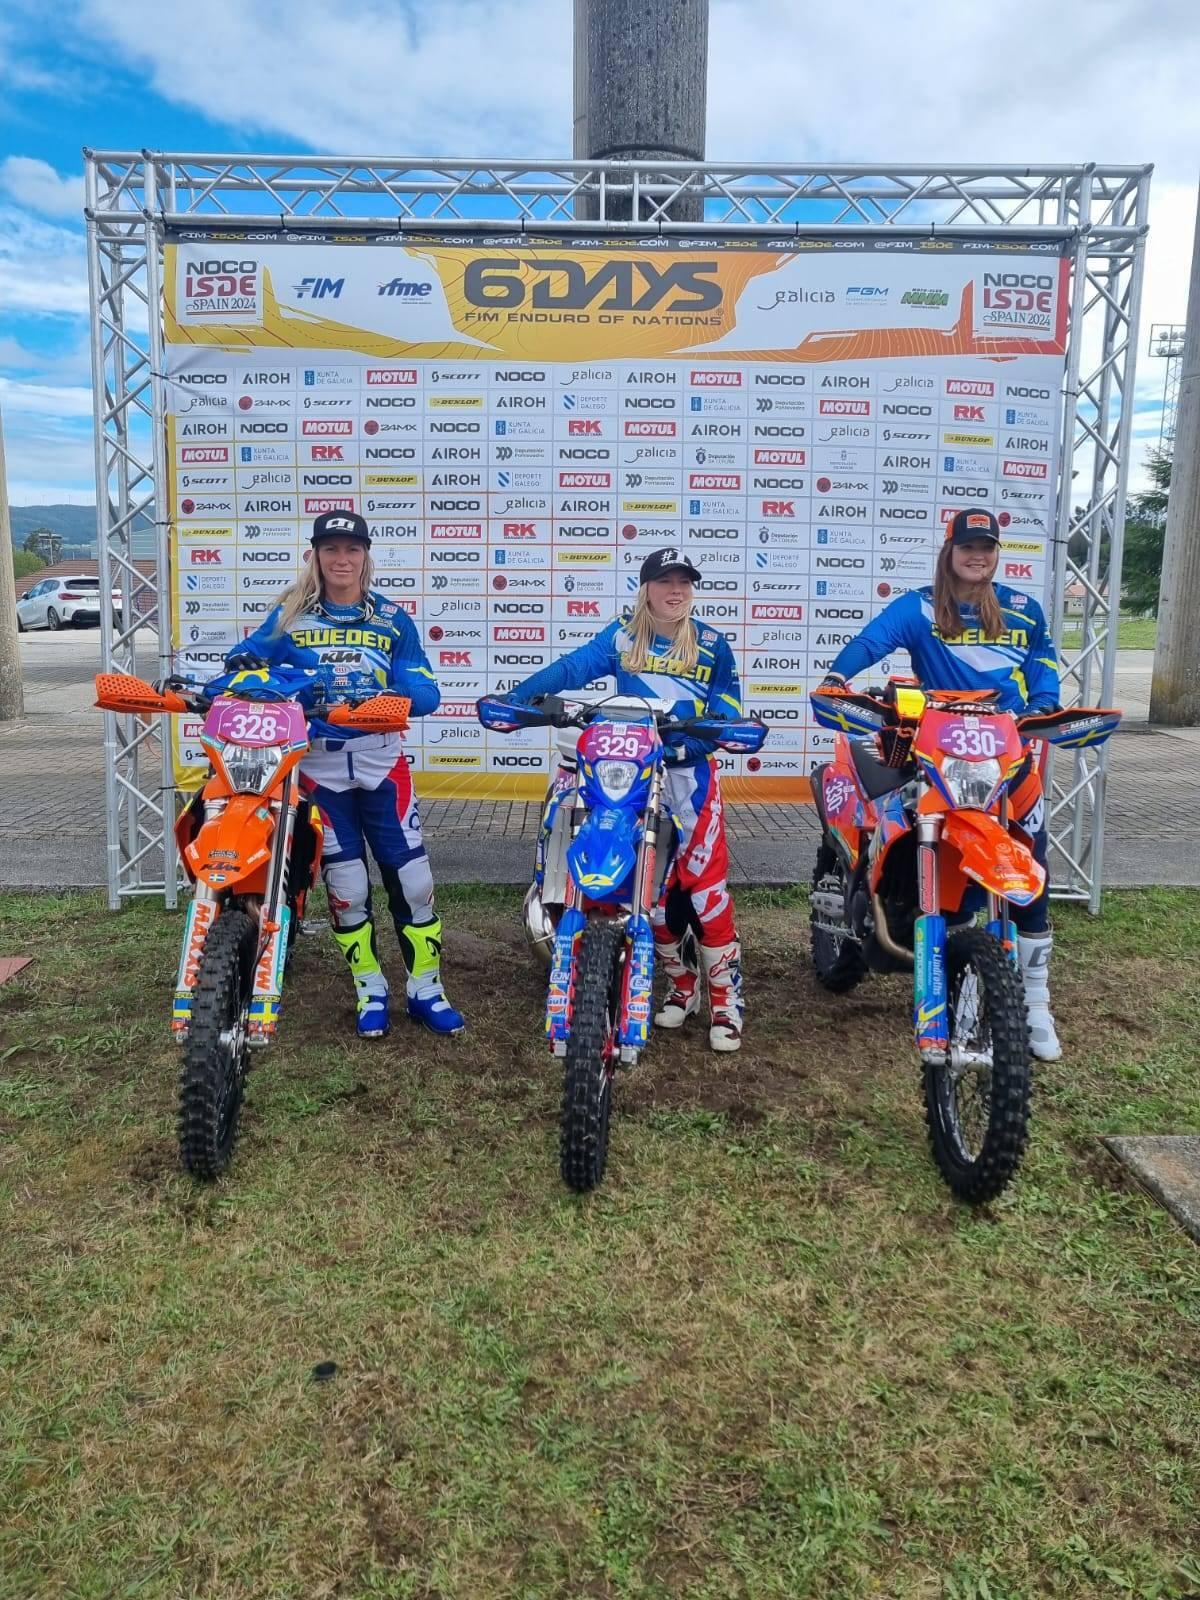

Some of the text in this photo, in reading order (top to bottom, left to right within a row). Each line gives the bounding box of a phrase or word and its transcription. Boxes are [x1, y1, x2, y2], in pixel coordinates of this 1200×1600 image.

[186, 260, 257, 275] NOCO
[186, 276, 256, 297] ISDE
[377, 278, 432, 296] rfme
[984, 273, 1053, 290] NOCO
[293, 278, 344, 298] FIM
[846, 287, 889, 295] FGM
[186, 298, 256, 310] SPAIN 2024
[765, 288, 835, 309] galicia
[984, 290, 1052, 313] ISDE
[465, 312, 722, 326] FIM ENDURO OF NATIONS
[984, 311, 1050, 325] SPAIN 2024
[179, 374, 227, 384] NOCO
[242, 373, 290, 384] AIROH
[369, 372, 415, 383] MOTUL
[496, 372, 545, 382] NOCO
[566, 369, 612, 383] galicia
[627, 372, 676, 384] AIROH
[693, 373, 740, 384] MOTUL
[756, 375, 805, 385] NOCO
[821, 376, 870, 388] AIROH
[890, 376, 933, 390] galicia
[948, 382, 992, 395] MOTUL
[1006, 386, 1050, 399] NOCO
[185, 395, 227, 410] galicia
[367, 398, 415, 407] NOCO
[496, 397, 545, 408] AIROH
[625, 398, 675, 408] NOCO
[822, 402, 868, 414] MOTUL
[883, 405, 931, 416] NOCO
[954, 405, 984, 419] RK
[182, 424, 227, 435] AIROH
[241, 423, 288, 433] NOCO
[305, 423, 350, 433] MOTUL
[430, 423, 480, 432] NOCO
[569, 420, 601, 433] RK
[628, 423, 674, 434] MOTUL
[691, 425, 740, 436] AIROH
[755, 426, 804, 437] NOCO
[825, 425, 869, 439] galicia
[1006, 437, 1047, 451] AIROH
[184, 449, 226, 461] MOTUL
[312, 446, 343, 458] RK
[366, 448, 415, 458] NOCO
[431, 448, 480, 459] AIROH
[560, 449, 609, 459] NOCO
[631, 447, 676, 461] galicia
[756, 451, 803, 464] MOTUL
[883, 456, 930, 468] AIROH
[1004, 463, 1045, 476] MOTUL
[247, 472, 291, 487] galicia
[304, 475, 352, 485] NOCO
[431, 474, 480, 485] AIROH
[562, 474, 609, 486] MOTUL
[691, 476, 738, 488] MOTUL
[754, 479, 803, 489] NOCO
[833, 482, 869, 490] 24MX
[942, 486, 988, 498] NOCO
[244, 501, 291, 512] AIROH
[431, 500, 480, 510] NOCO
[500, 497, 546, 512] galicia
[560, 500, 610, 512] AIROH
[763, 501, 794, 515] RK
[818, 506, 866, 518] AIROH
[880, 508, 927, 519] NOCO
[433, 525, 479, 537] MOTUL
[504, 524, 536, 536] RK
[559, 527, 609, 536] NOCO
[689, 528, 738, 538] NOCO
[191, 550, 221, 562] RK
[243, 552, 290, 562] NOCO
[431, 552, 480, 561] NOCO
[816, 557, 864, 568] NOCO
[1005, 563, 1033, 577] RK
[436, 600, 480, 614] galicia
[494, 604, 543, 613] NOCO
[567, 601, 600, 613] RK
[754, 606, 800, 619] MOTUL
[815, 608, 863, 619] NOCO
[291, 629, 390, 648] SWEDEN
[445, 630, 480, 638] 24MX
[496, 628, 542, 640] MOTUL
[757, 630, 801, 644] galicia
[321, 650, 361, 664] KTM
[440, 652, 471, 663] RK
[494, 655, 543, 664] NOCO
[752, 659, 800, 669] AIROH
[231, 715, 276, 741] 328
[435, 727, 480, 741] galicia
[596, 737, 638, 757] 329
[952, 730, 996, 756] 330
[493, 757, 542, 767] NOCO
[184, 903, 211, 987] MAXXIS
